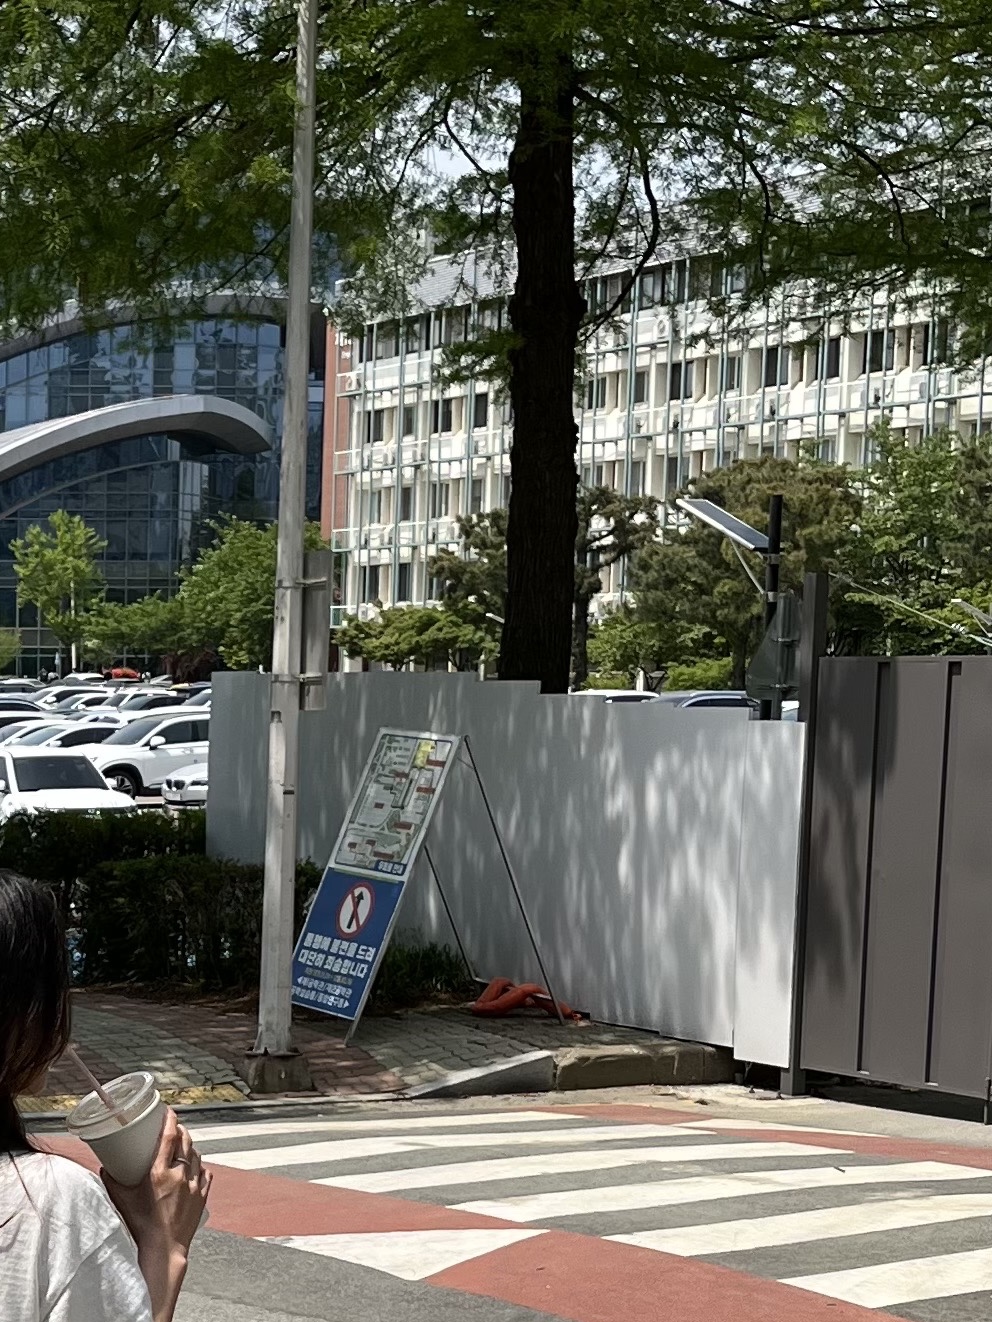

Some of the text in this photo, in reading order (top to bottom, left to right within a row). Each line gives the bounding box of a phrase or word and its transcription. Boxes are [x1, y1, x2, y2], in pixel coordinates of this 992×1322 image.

[298, 949, 326, 968] 대단히
[323, 955, 368, 979] 죄송합니다
[356, 945, 376, 962] 드려
